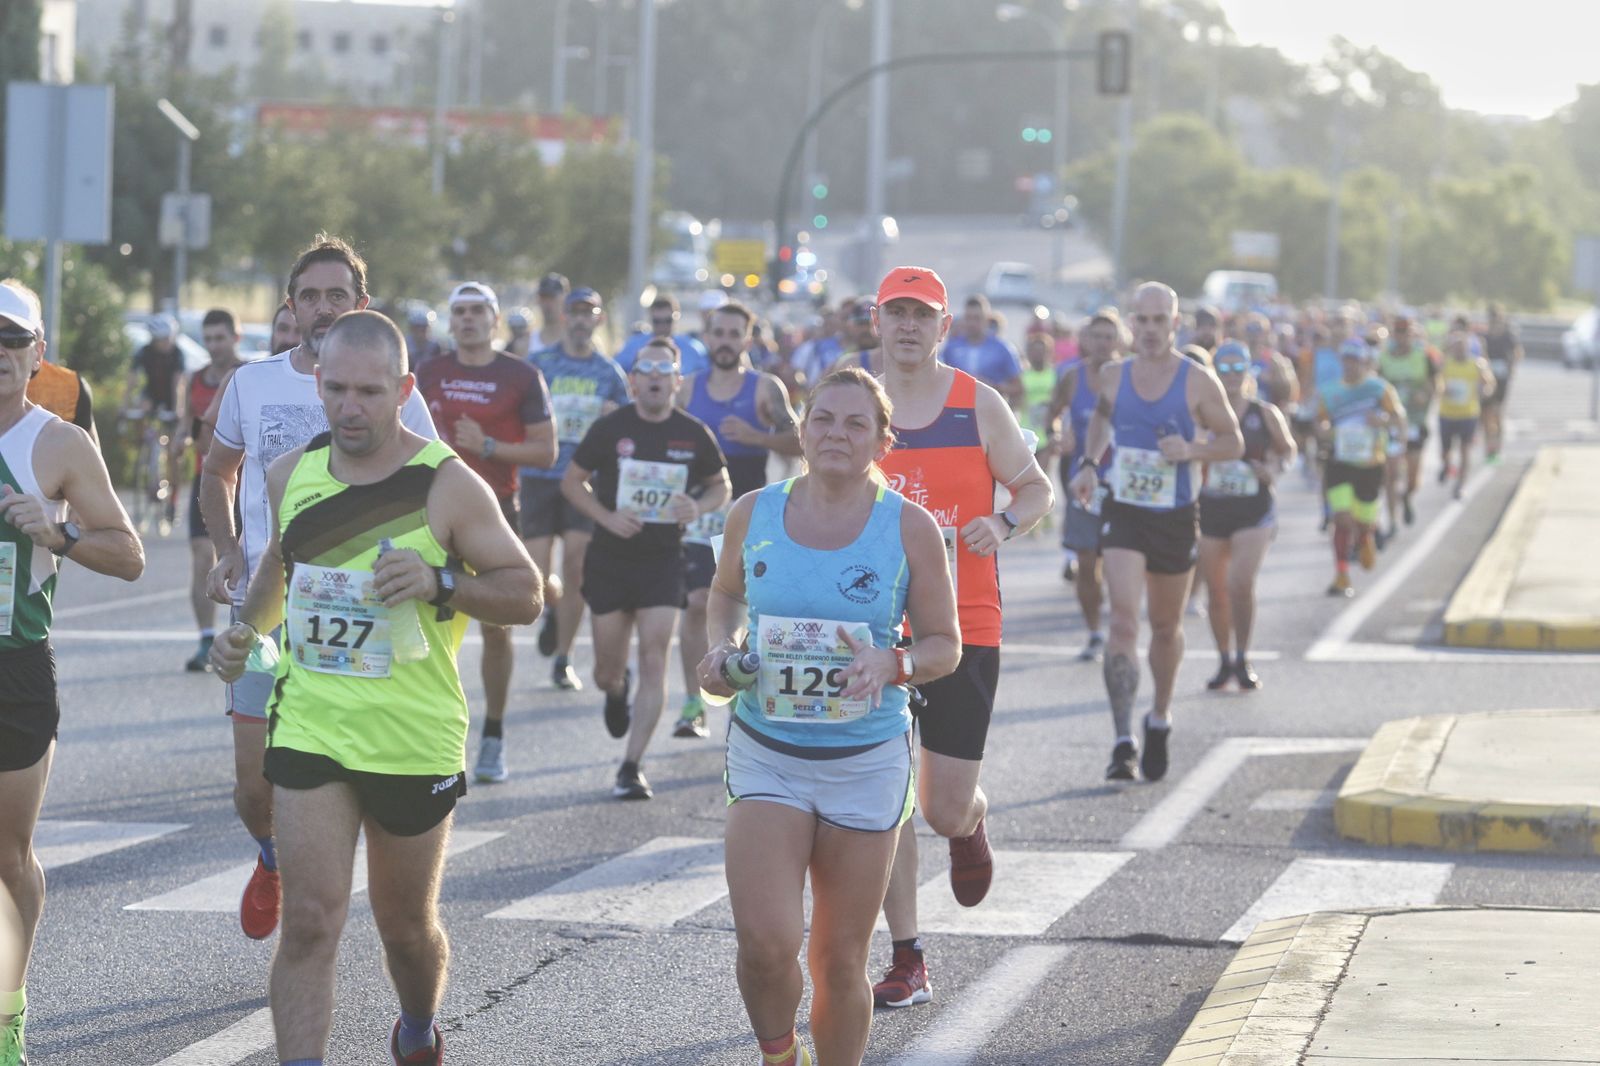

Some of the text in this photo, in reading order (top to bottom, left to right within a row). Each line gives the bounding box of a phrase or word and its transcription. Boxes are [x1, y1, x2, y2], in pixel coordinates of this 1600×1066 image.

[267, 433, 282, 446] TRAIL
[1128, 472, 1163, 493] 229
[632, 489, 671, 507] 407
[321, 571, 351, 583] XXXV
[306, 615, 374, 649] 127
[793, 622, 823, 633] XXXV
[779, 666, 849, 698] 129
